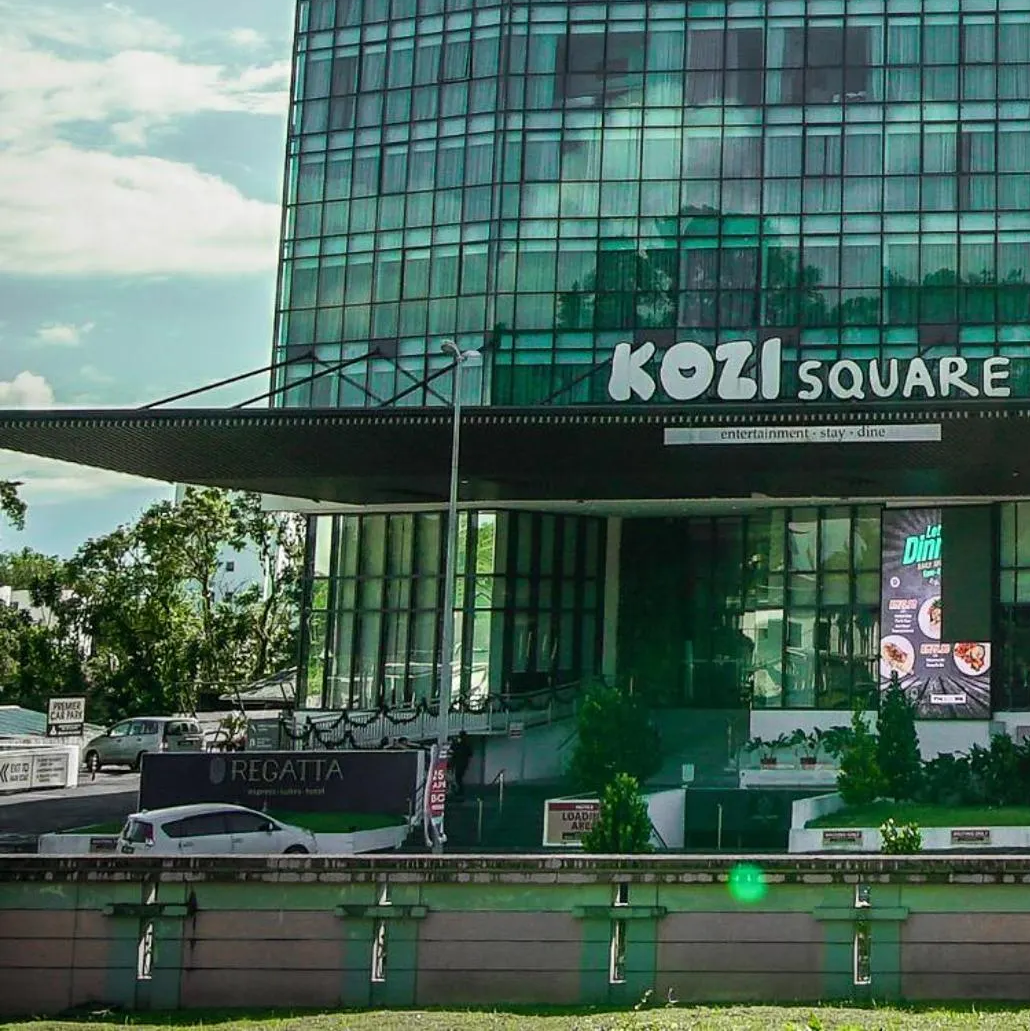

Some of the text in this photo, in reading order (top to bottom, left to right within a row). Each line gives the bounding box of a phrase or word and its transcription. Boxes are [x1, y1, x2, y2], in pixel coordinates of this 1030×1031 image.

[607, 336, 1011, 402] KOZI SQUARE
[721, 424, 886, 443] entertainment stay dine
[231, 758, 344, 782] REGATTA
